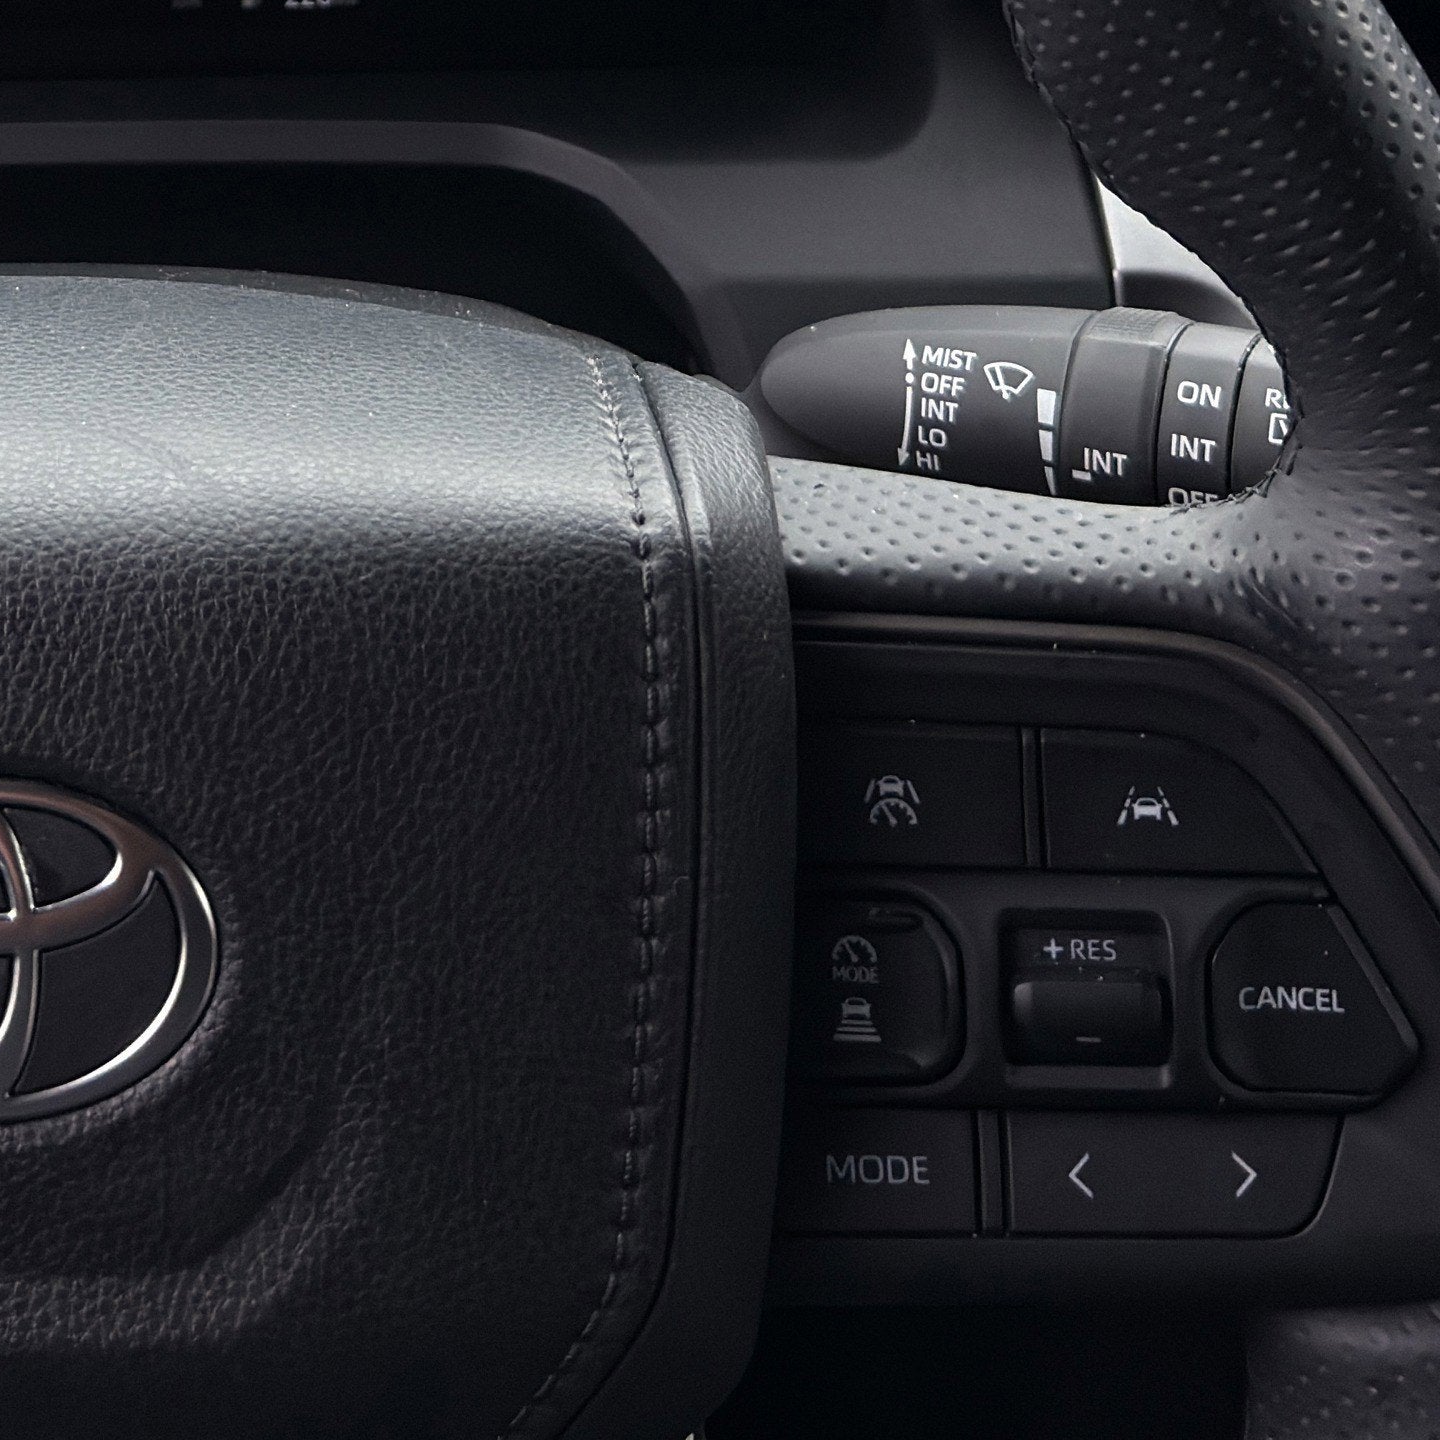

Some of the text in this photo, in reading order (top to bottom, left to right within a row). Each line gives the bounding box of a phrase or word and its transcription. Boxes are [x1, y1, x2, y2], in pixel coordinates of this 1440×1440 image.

[921, 346, 977, 371] MIST
[921, 373, 965, 397] OFF
[1177, 381, 1221, 408] ON
[921, 399, 959, 423] INT
[917, 426, 947, 448] LO
[1171, 434, 1215, 462] INT
[916, 451, 940, 471] HI
[1084, 447, 1127, 476] INT
[831, 963, 879, 984] MODE
[1238, 985, 1346, 1013] CANCEL
[826, 1154, 930, 1186] MODE
